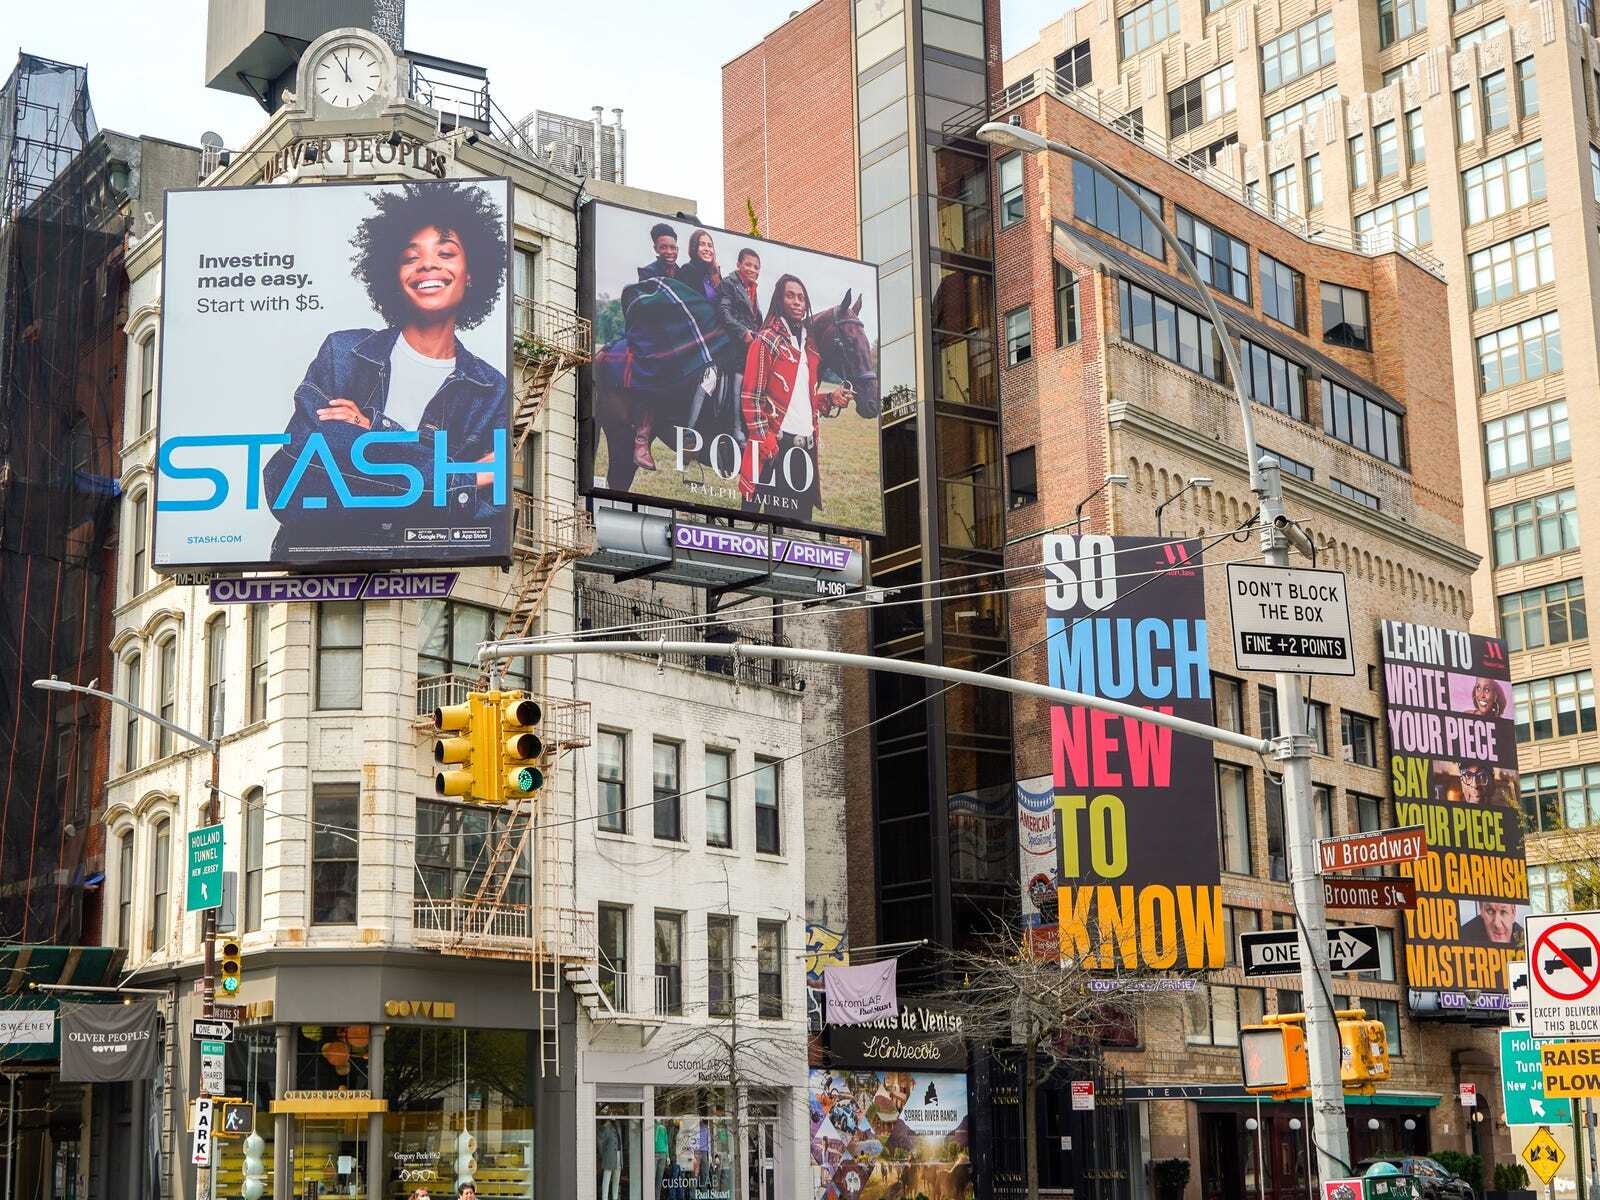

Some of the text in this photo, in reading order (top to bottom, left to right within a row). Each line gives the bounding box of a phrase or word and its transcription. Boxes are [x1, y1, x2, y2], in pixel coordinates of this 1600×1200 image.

[262, 138, 447, 184] OLIVR PEOPLES
[199, 252, 295, 269] Investing
[197, 273, 313, 289] made easy.
[196, 293, 324, 314] Start with $5.
[157, 428, 507, 511] STASH
[672, 425, 814, 493] POLO
[689, 482, 800, 510] RALPH LAUREN
[186, 534, 243, 545] STASH.COM
[676, 527, 845, 566] OUTFRONT PRIME
[1042, 534, 1118, 611] SO
[214, 574, 447, 601] OUTFRONT PRIME
[816, 579, 847, 596] M-1061
[1237, 580, 1338, 603] DON'T BLOCK
[1258, 603, 1324, 623] THE BOX
[1245, 634, 1342, 657] FINE +2 POINTS
[1381, 618, 1473, 670] LEARN TO
[1046, 617, 1212, 700] MUCH
[1384, 663, 1448, 711] WRITE
[1050, 704, 1175, 788] NEW
[1387, 708, 1499, 763] YOUR PIECE
[1391, 755, 1430, 800] SAY
[1055, 793, 1129, 879] TO
[1395, 801, 1506, 852] YOUR PIECE
[191, 831, 220, 848] HOLLAND
[194, 848, 218, 863] TUNNEL
[1323, 845, 1336, 867] W
[1343, 836, 1421, 865] Broadway
[1445, 852, 1528, 900] GARNISH
[1324, 883, 1398, 907] Broome St
[1057, 884, 1226, 970] KNOW
[1404, 896, 1460, 941] YOUR
[1262, 943, 1300, 963] ONE
[1405, 943, 1527, 989] MASTERPI
[1444, 994, 1499, 1008] OUTONT
[1534, 1005, 1600, 1018] EXCEPT DELIVERI
[0, 1022, 52, 1031] SWEENEY
[198, 1026, 228, 1035] ONE WAY
[901, 1005, 917, 1031] de
[918, 1006, 963, 1033] Venise
[1544, 1019, 1599, 1031] THIS BLOCK
[68, 1029, 150, 1043] OLIVER PEOPLES
[1515, 1060, 1543, 1073] Tunn
[1543, 1049, 1600, 1067] RAISE
[283, 1089, 372, 1100] OLIVER PEOPLES
[1506, 1080, 1527, 1091] New
[1546, 1074, 1600, 1092] PLOW
[904, 1109, 957, 1121] SORREL RIVER RANCH
[197, 1101, 209, 1154] PARK
[695, 1189, 710, 1199] Paul
